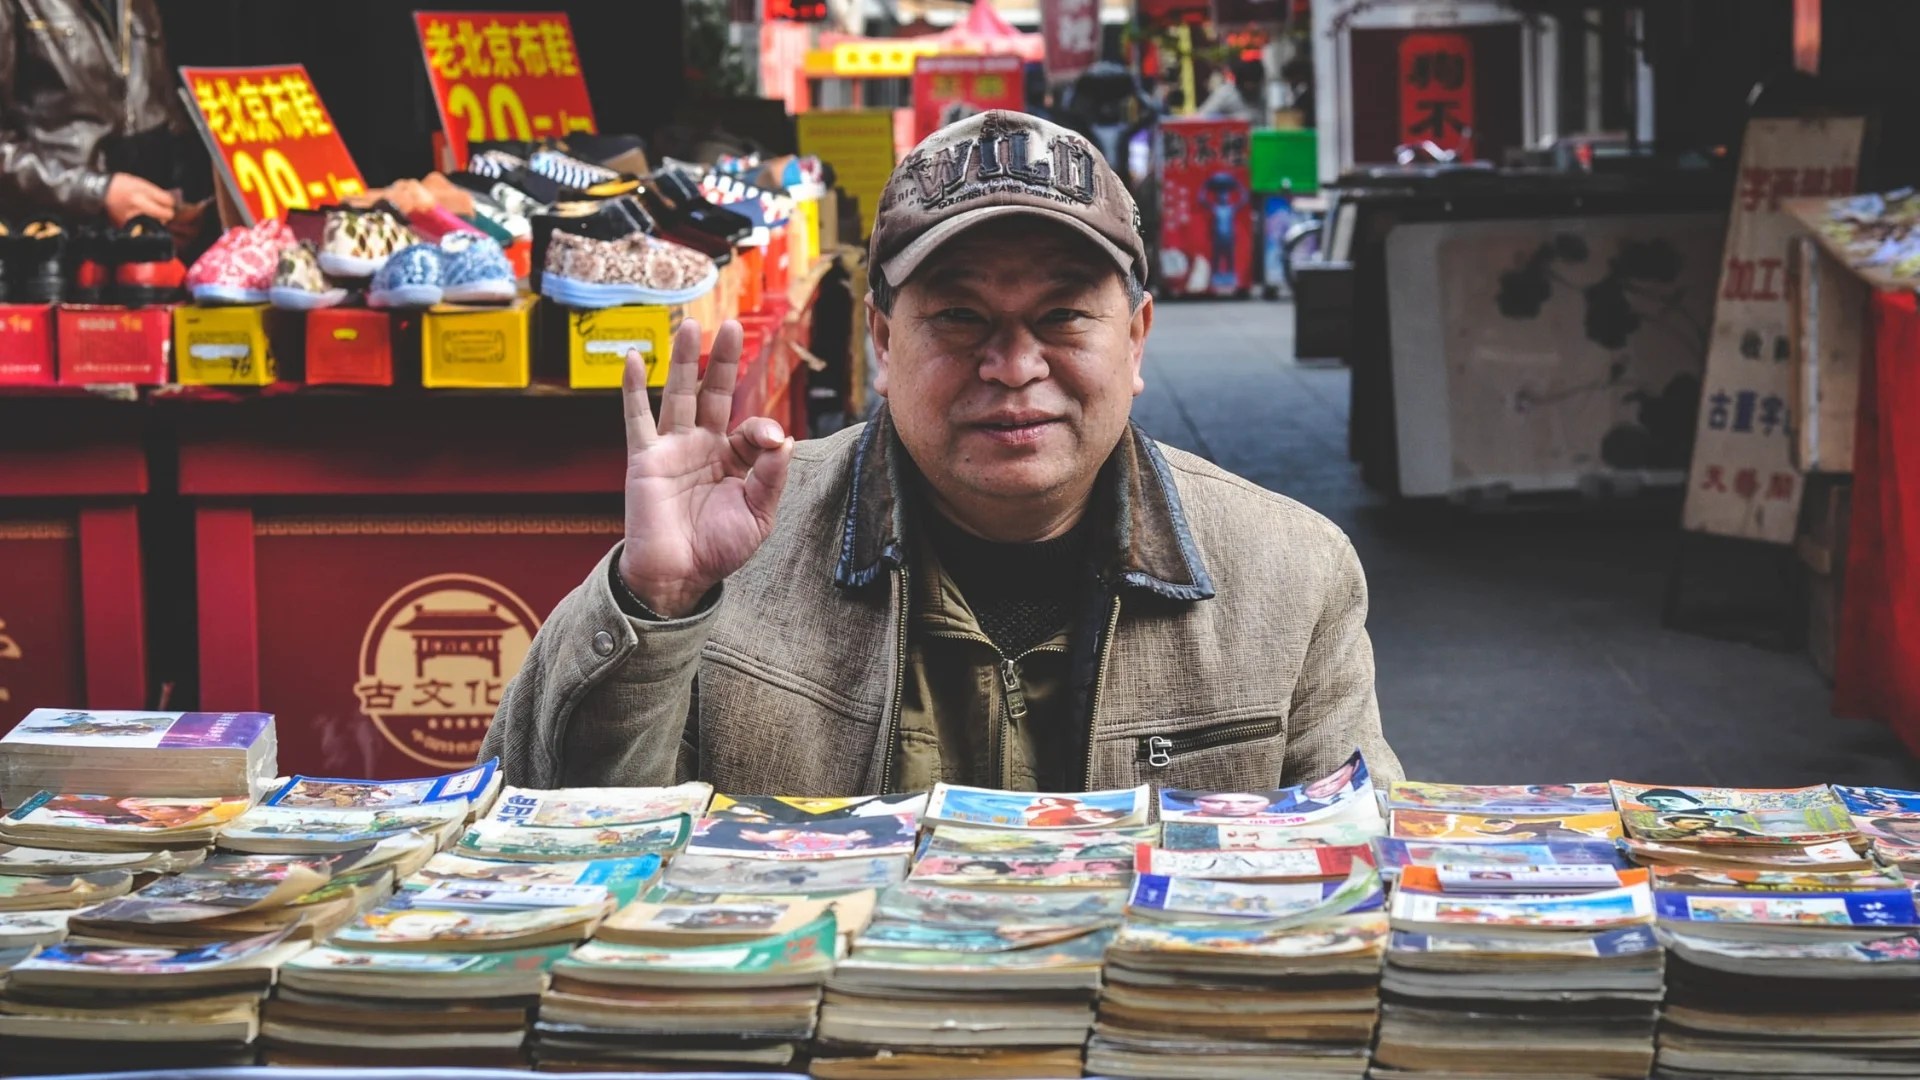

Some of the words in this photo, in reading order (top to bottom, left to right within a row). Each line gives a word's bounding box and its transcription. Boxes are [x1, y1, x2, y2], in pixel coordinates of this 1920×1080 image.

[425, 19, 578, 79] 老北京布鞋
[195, 73, 333, 145] 老北京布鞋
[905, 131, 1096, 209] WILD
[1024, 187, 1074, 206] COMPANY
[1723, 257, 1783, 301] 加工
[1708, 390, 1793, 437] 古董字
[359, 679, 501, 709] 古文化
